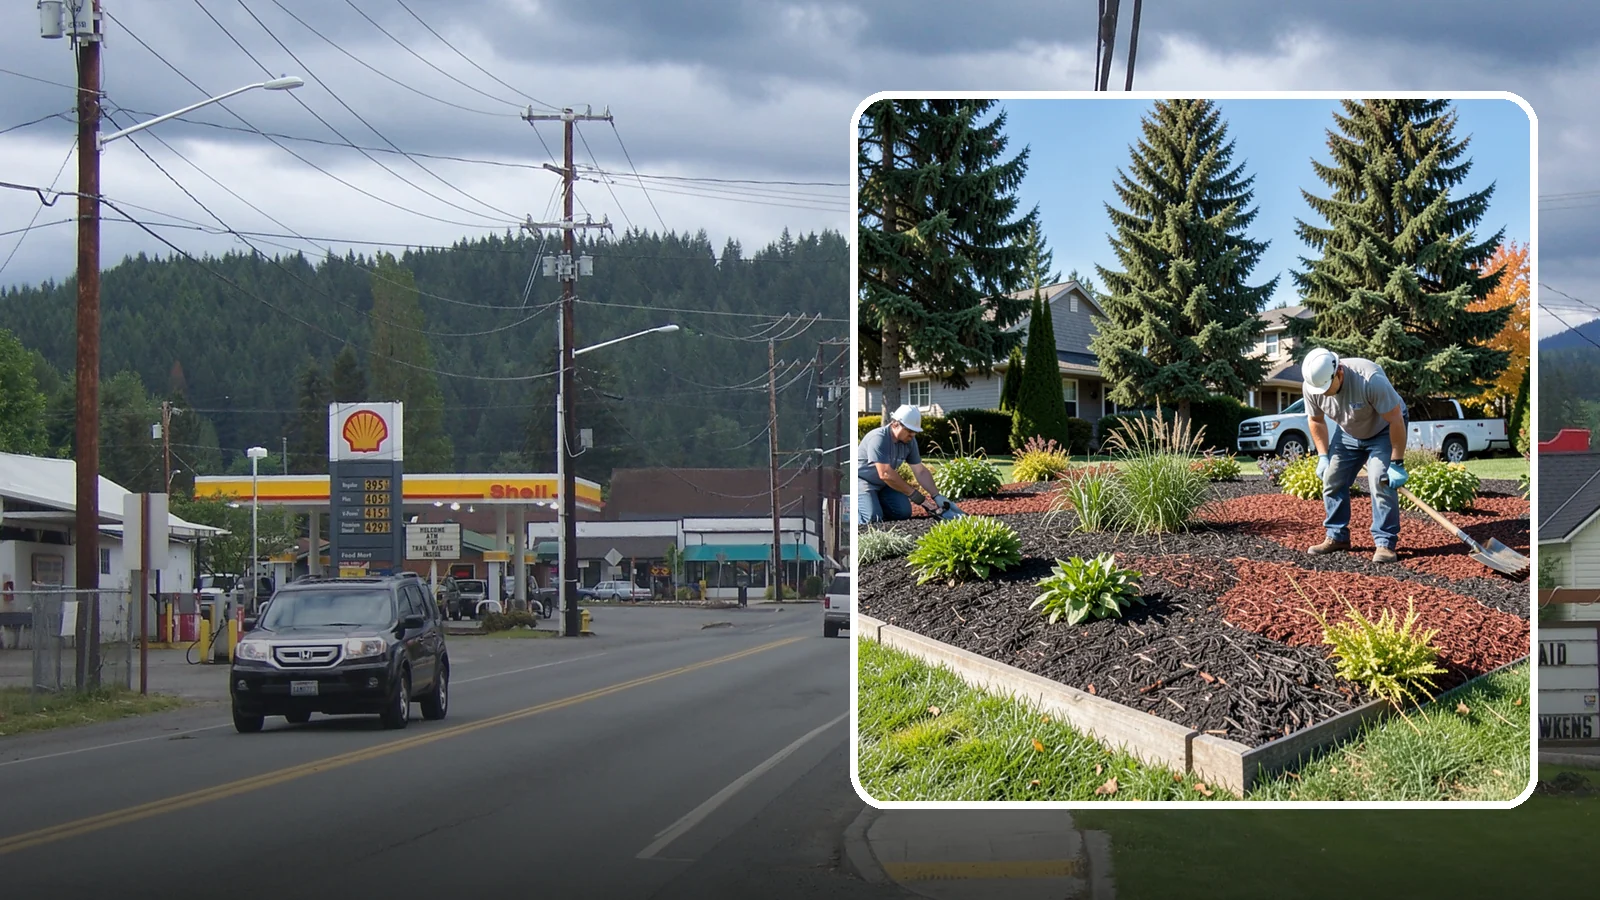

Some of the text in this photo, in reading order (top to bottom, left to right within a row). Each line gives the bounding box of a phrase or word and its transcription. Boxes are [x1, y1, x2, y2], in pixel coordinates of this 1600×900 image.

[342, 494, 351, 502] Plus
[490, 484, 547, 498] Shell
[1539, 643, 1566, 666] AID
[1539, 716, 1592, 739] WKENS
